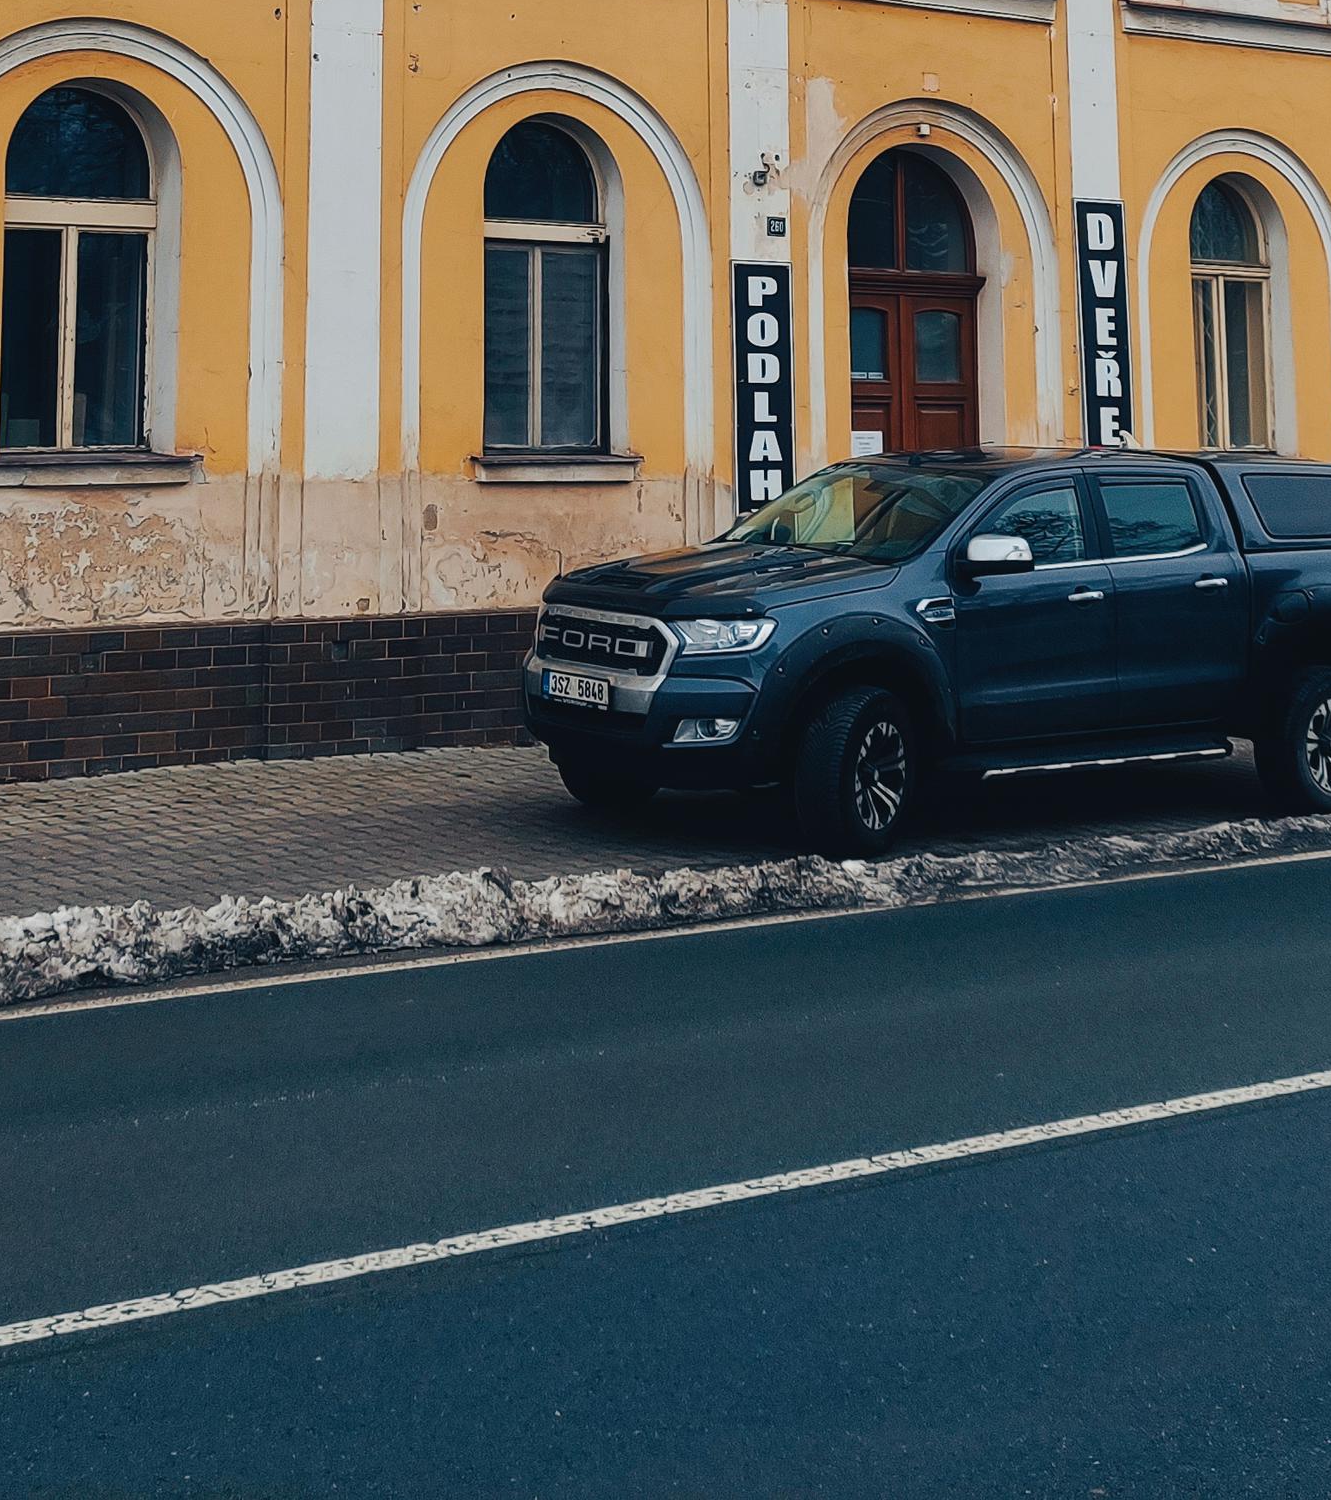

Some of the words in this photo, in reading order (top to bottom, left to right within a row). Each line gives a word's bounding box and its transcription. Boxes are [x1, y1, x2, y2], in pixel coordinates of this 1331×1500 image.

[770, 220, 784, 233] 260
[1086, 213, 1123, 446] DVEŘE
[746, 276, 783, 513] PODLAH
[540, 625, 654, 658] FORD
[551, 674, 571, 695] 3SZ
[577, 679, 604, 701] 5848
